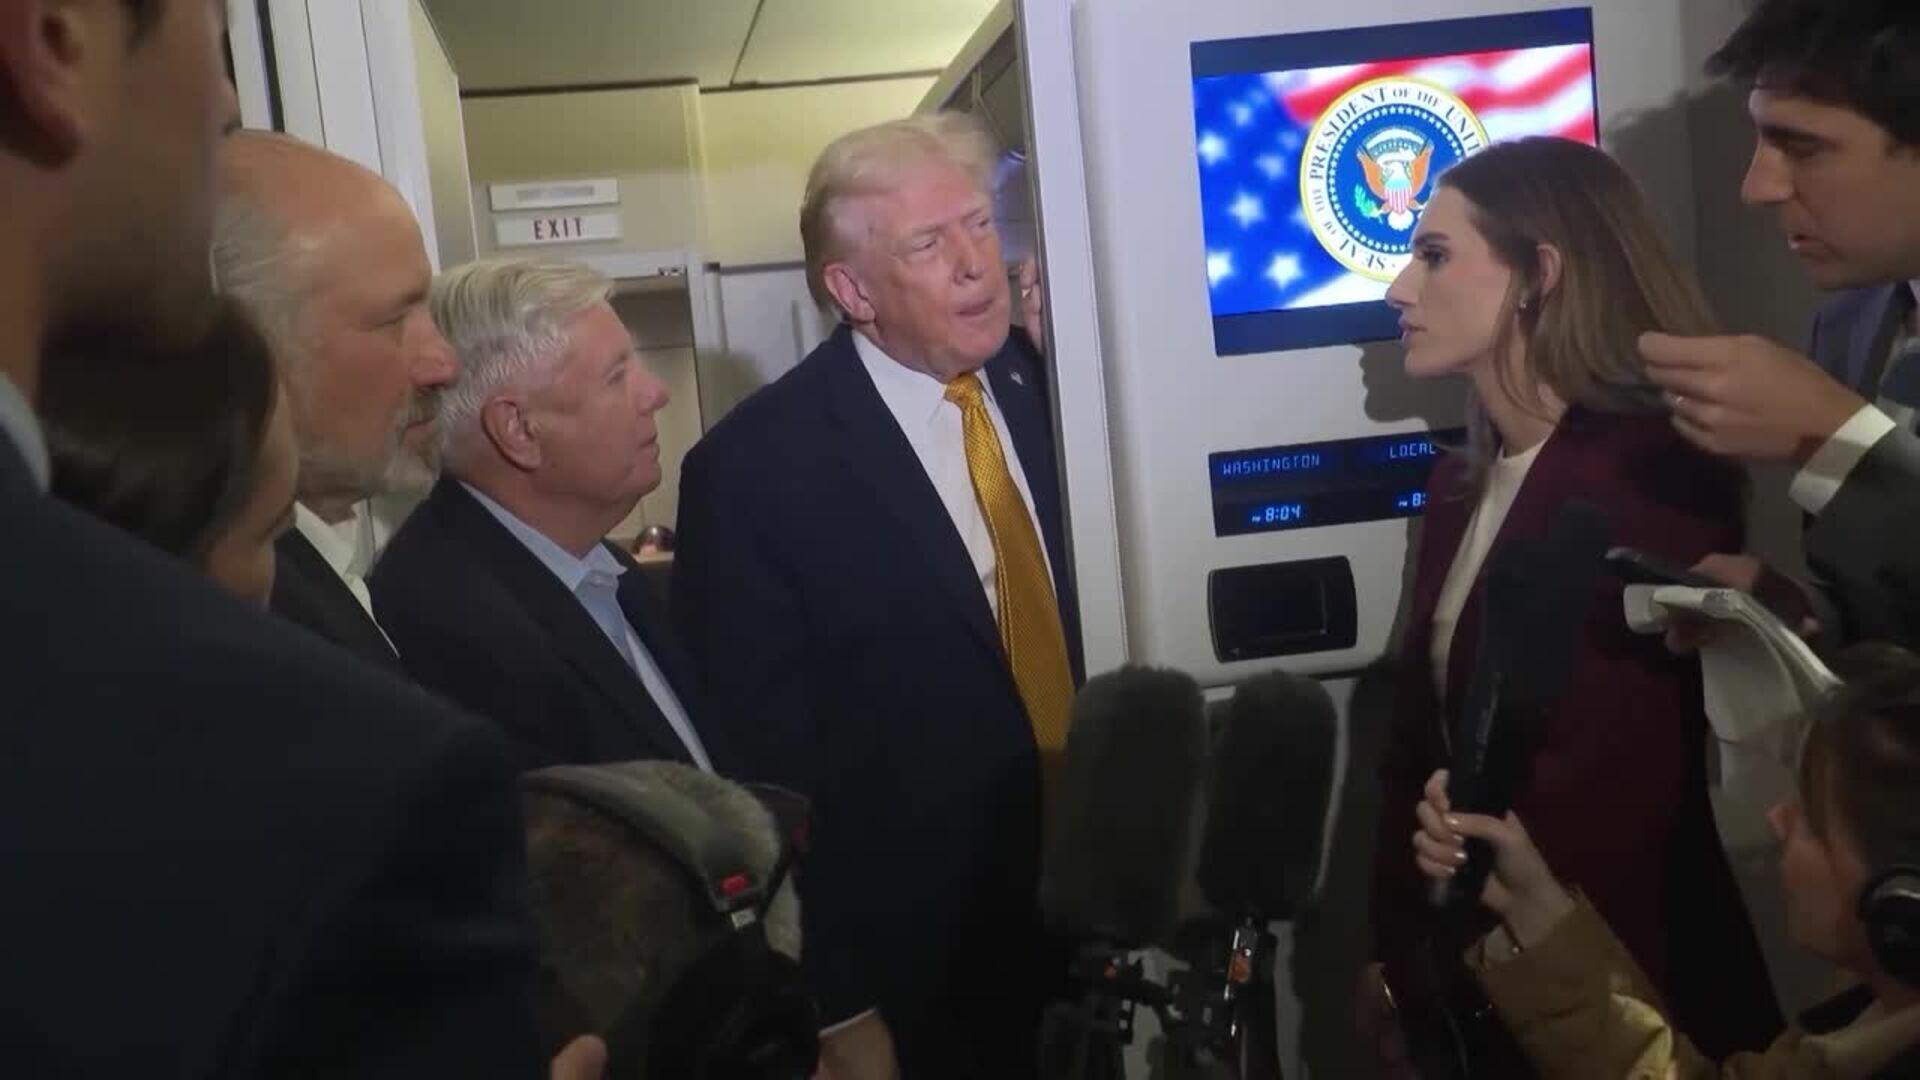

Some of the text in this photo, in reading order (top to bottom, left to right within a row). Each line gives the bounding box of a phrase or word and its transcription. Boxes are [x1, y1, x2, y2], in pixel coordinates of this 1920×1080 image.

[1309, 86, 1387, 179] PRESIDENT
[1445, 105, 1480, 151] UNIT
[533, 217, 582, 240] EXIT
[1388, 442, 1437, 458] LOCAL
[1222, 453, 1320, 475] WASHINGTON
[1265, 504, 1301, 523] 8:04
